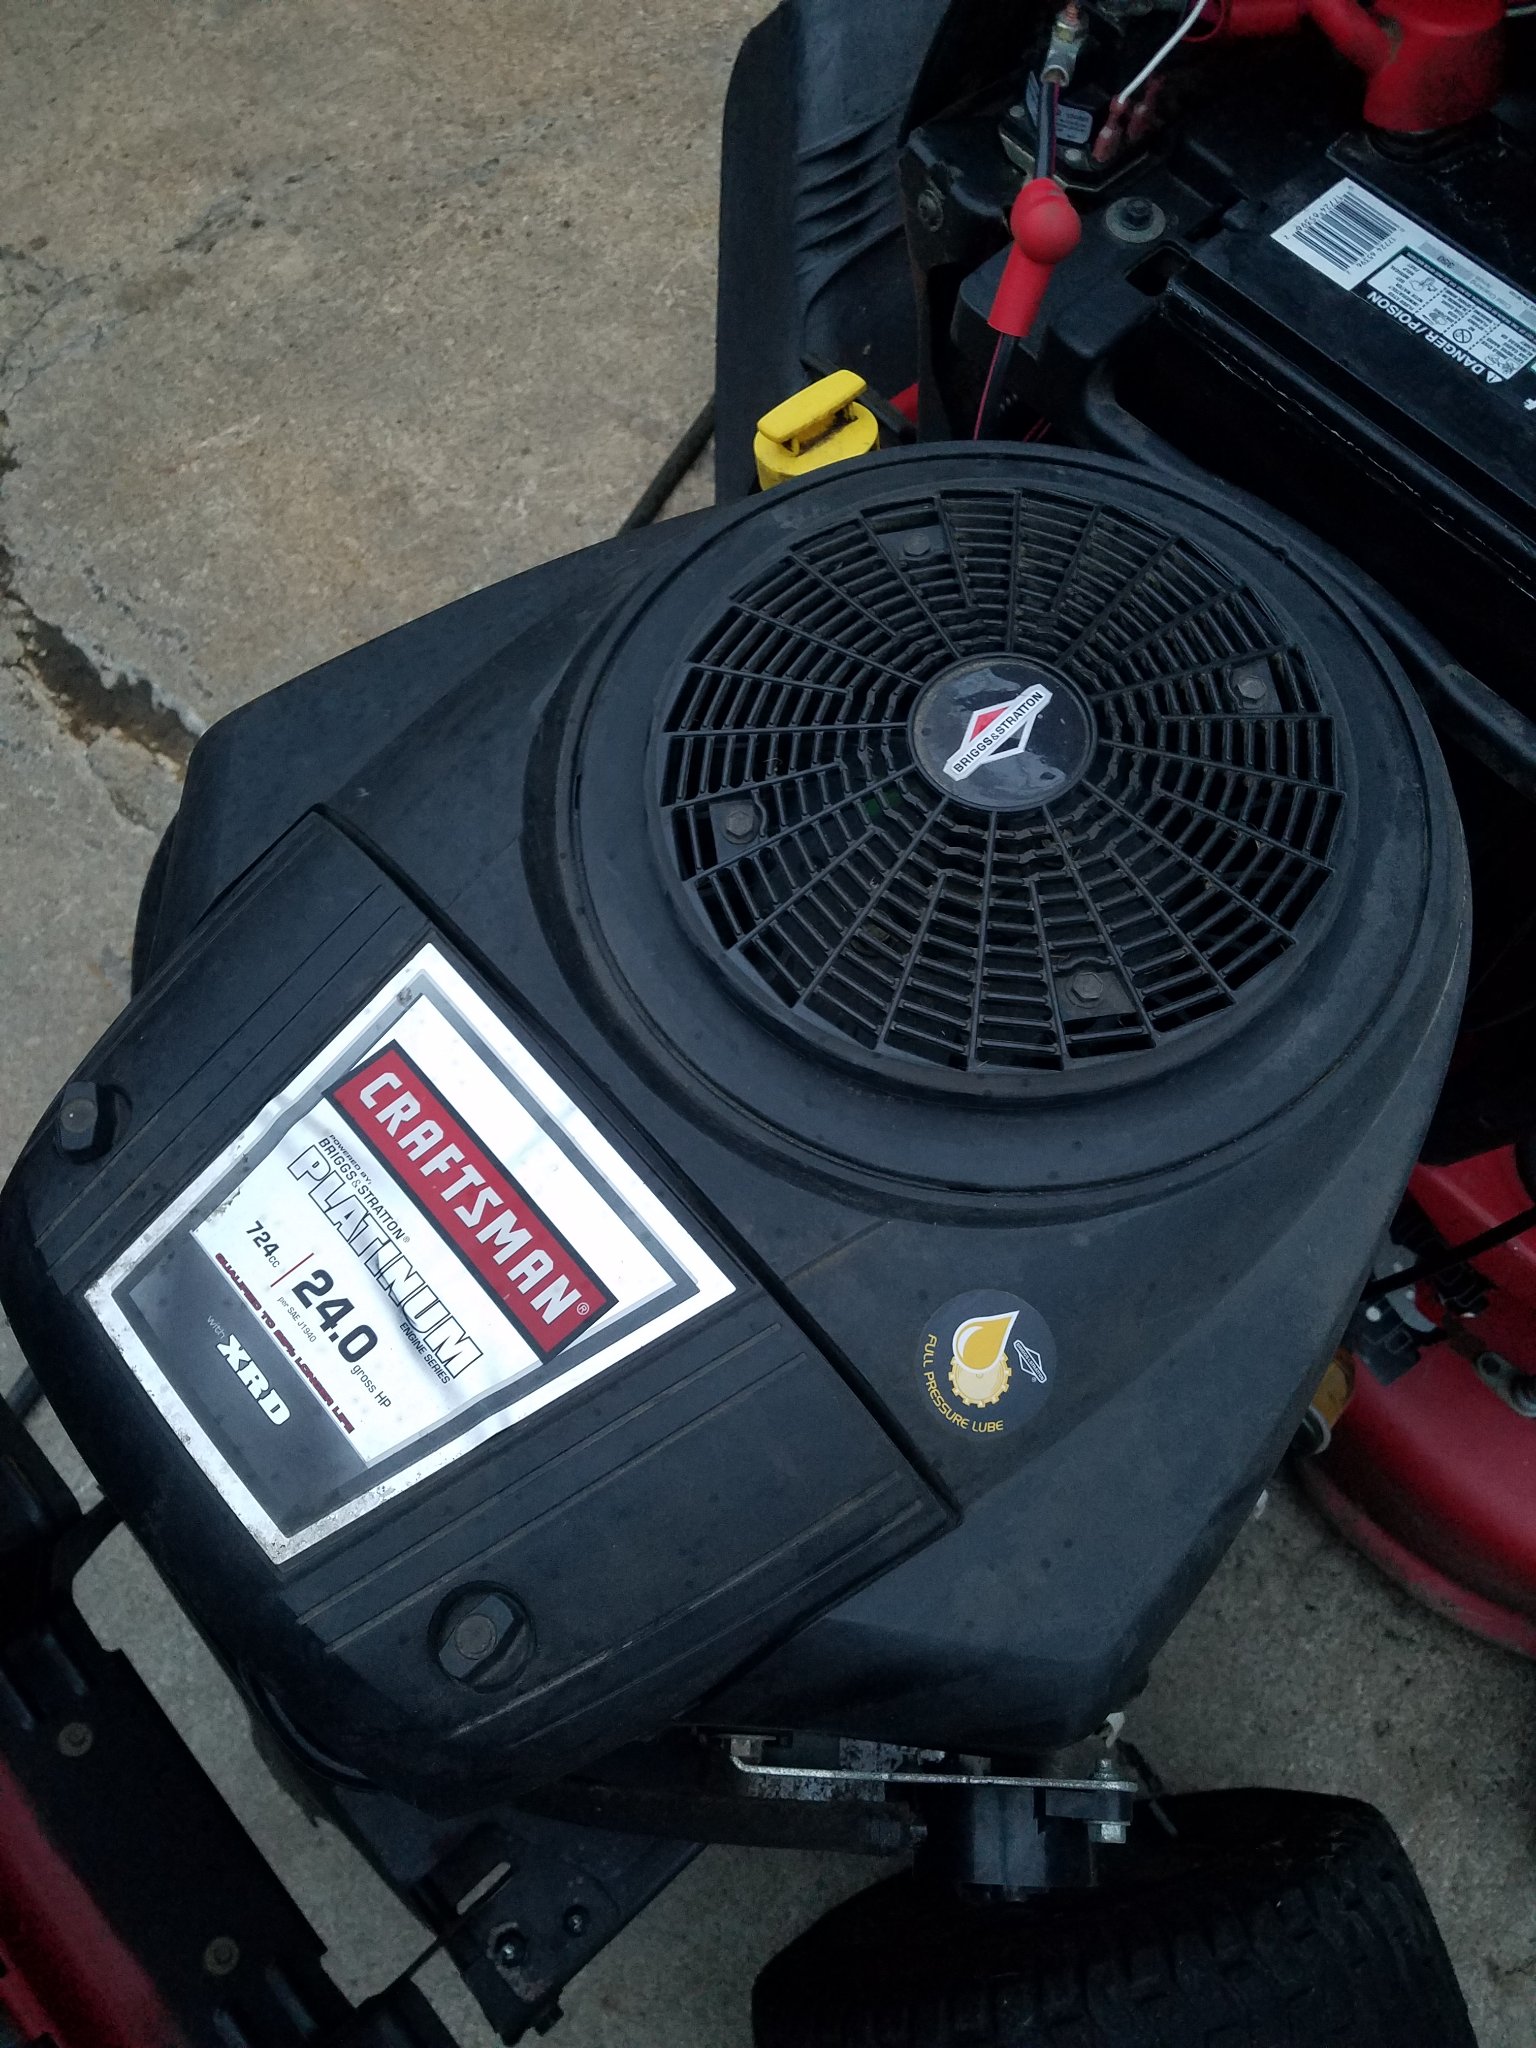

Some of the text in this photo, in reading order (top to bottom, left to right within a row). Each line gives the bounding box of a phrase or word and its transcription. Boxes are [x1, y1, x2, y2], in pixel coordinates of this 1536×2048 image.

[1424, 331, 1486, 376] DANGER
[330, 1134, 361, 1170] POWERED
[287, 1144, 484, 1379] PLATINUM
[207, 1315, 226, 1339] with
[261, 1310, 276, 1329] TO
[277, 1296, 317, 1343] per SAE J1940
[292, 1269, 378, 1363] 24.0
[350, 1365, 377, 1393] gross
[374, 1391, 392, 1408] HP
[216, 1333, 291, 1426] XRD
[400, 1322, 451, 1384] ENGINE SERIES
[923, 1334, 1004, 1433] FULL PRESSURE LUBE
